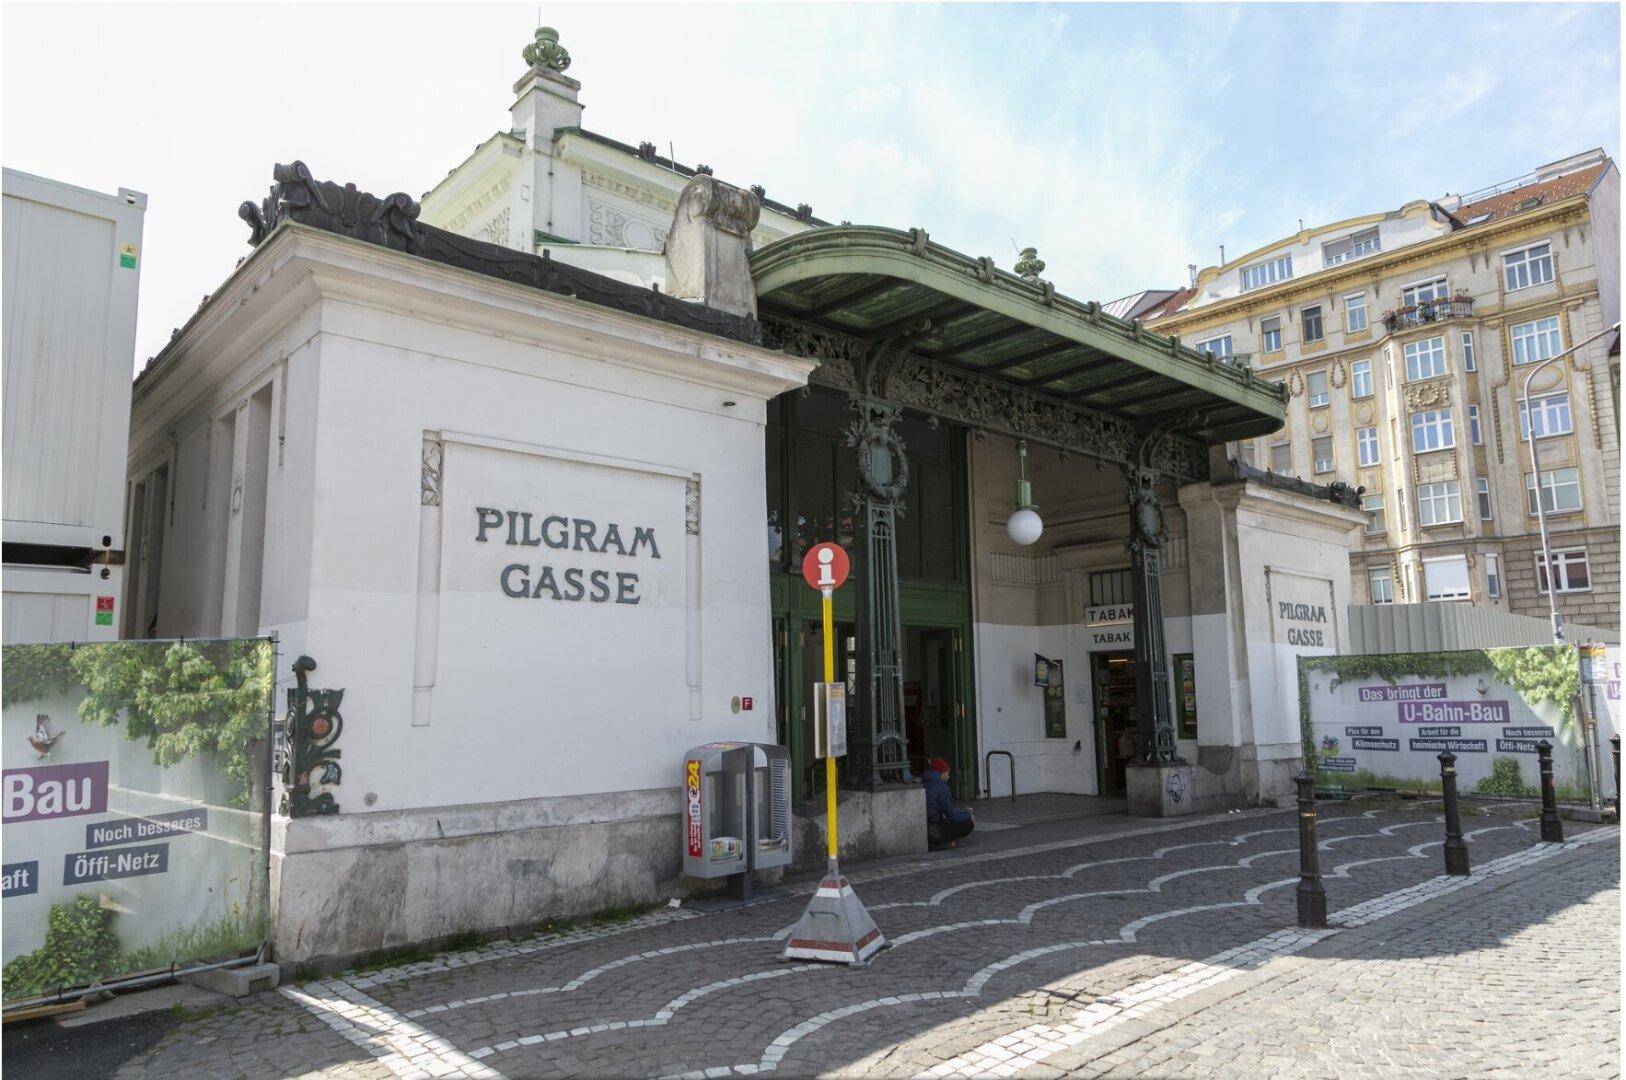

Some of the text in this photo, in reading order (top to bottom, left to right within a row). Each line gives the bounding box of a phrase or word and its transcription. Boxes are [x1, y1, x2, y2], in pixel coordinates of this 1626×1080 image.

[475, 506, 661, 559] PILGRAM
[500, 563, 641, 605] GASSE
[1279, 601, 1327, 623] PILGRAM
[1092, 632, 1131, 644] TABAK
[1287, 628, 1323, 647] GASSE
[1362, 685, 1443, 702] Das bringt der
[1403, 702, 1504, 722] U-Bahn-Bau
[1505, 729, 1522, 737] Noch
[1355, 740, 1397, 749] Klimaschutz
[1412, 740, 1485, 751] heimische Wirtschaft
[2, 774, 92, 819] Bau
[93, 815, 201, 844] Noch besseres
[74, 851, 160, 878] Öffi-Netz
